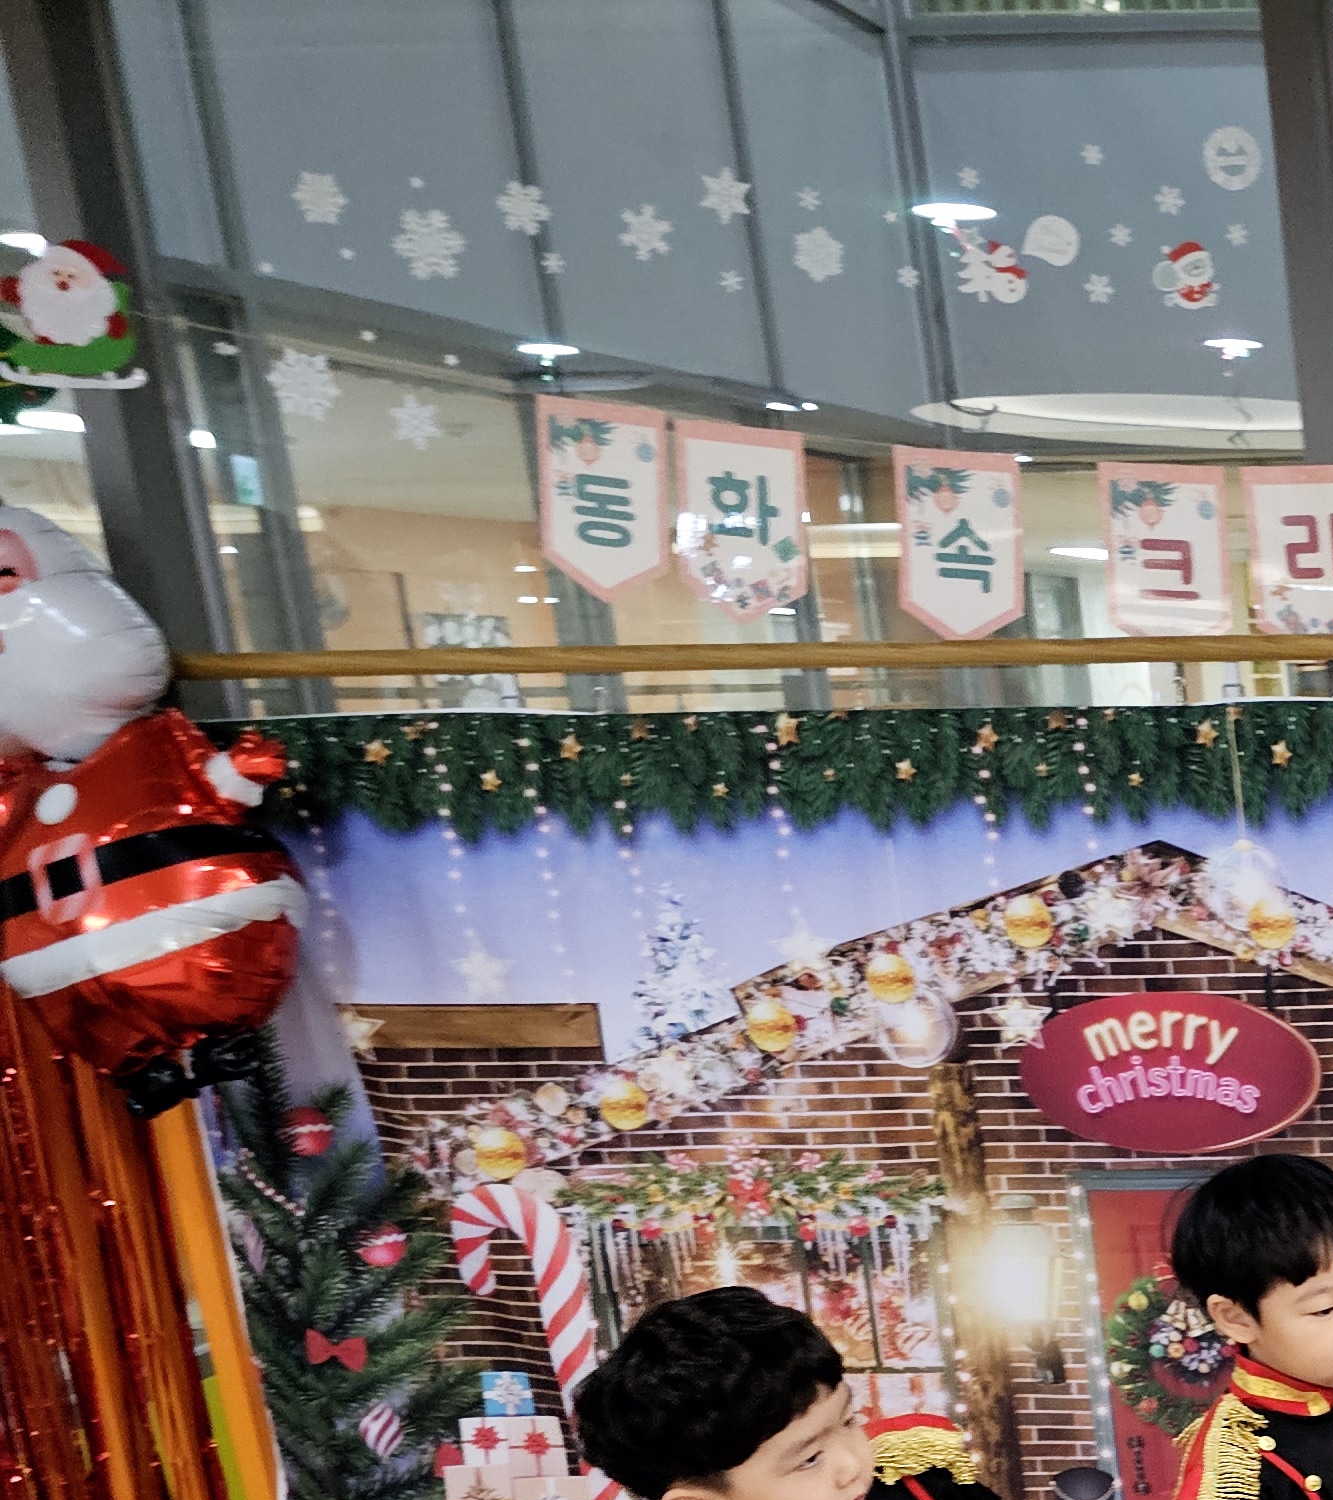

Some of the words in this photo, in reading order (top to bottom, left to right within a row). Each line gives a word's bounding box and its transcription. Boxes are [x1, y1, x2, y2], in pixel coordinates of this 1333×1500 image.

[574, 471, 779, 549] 동화
[934, 517, 993, 594] 속
[1083, 1010, 1240, 1066] merry
[1076, 1054, 1262, 1114] christmas
